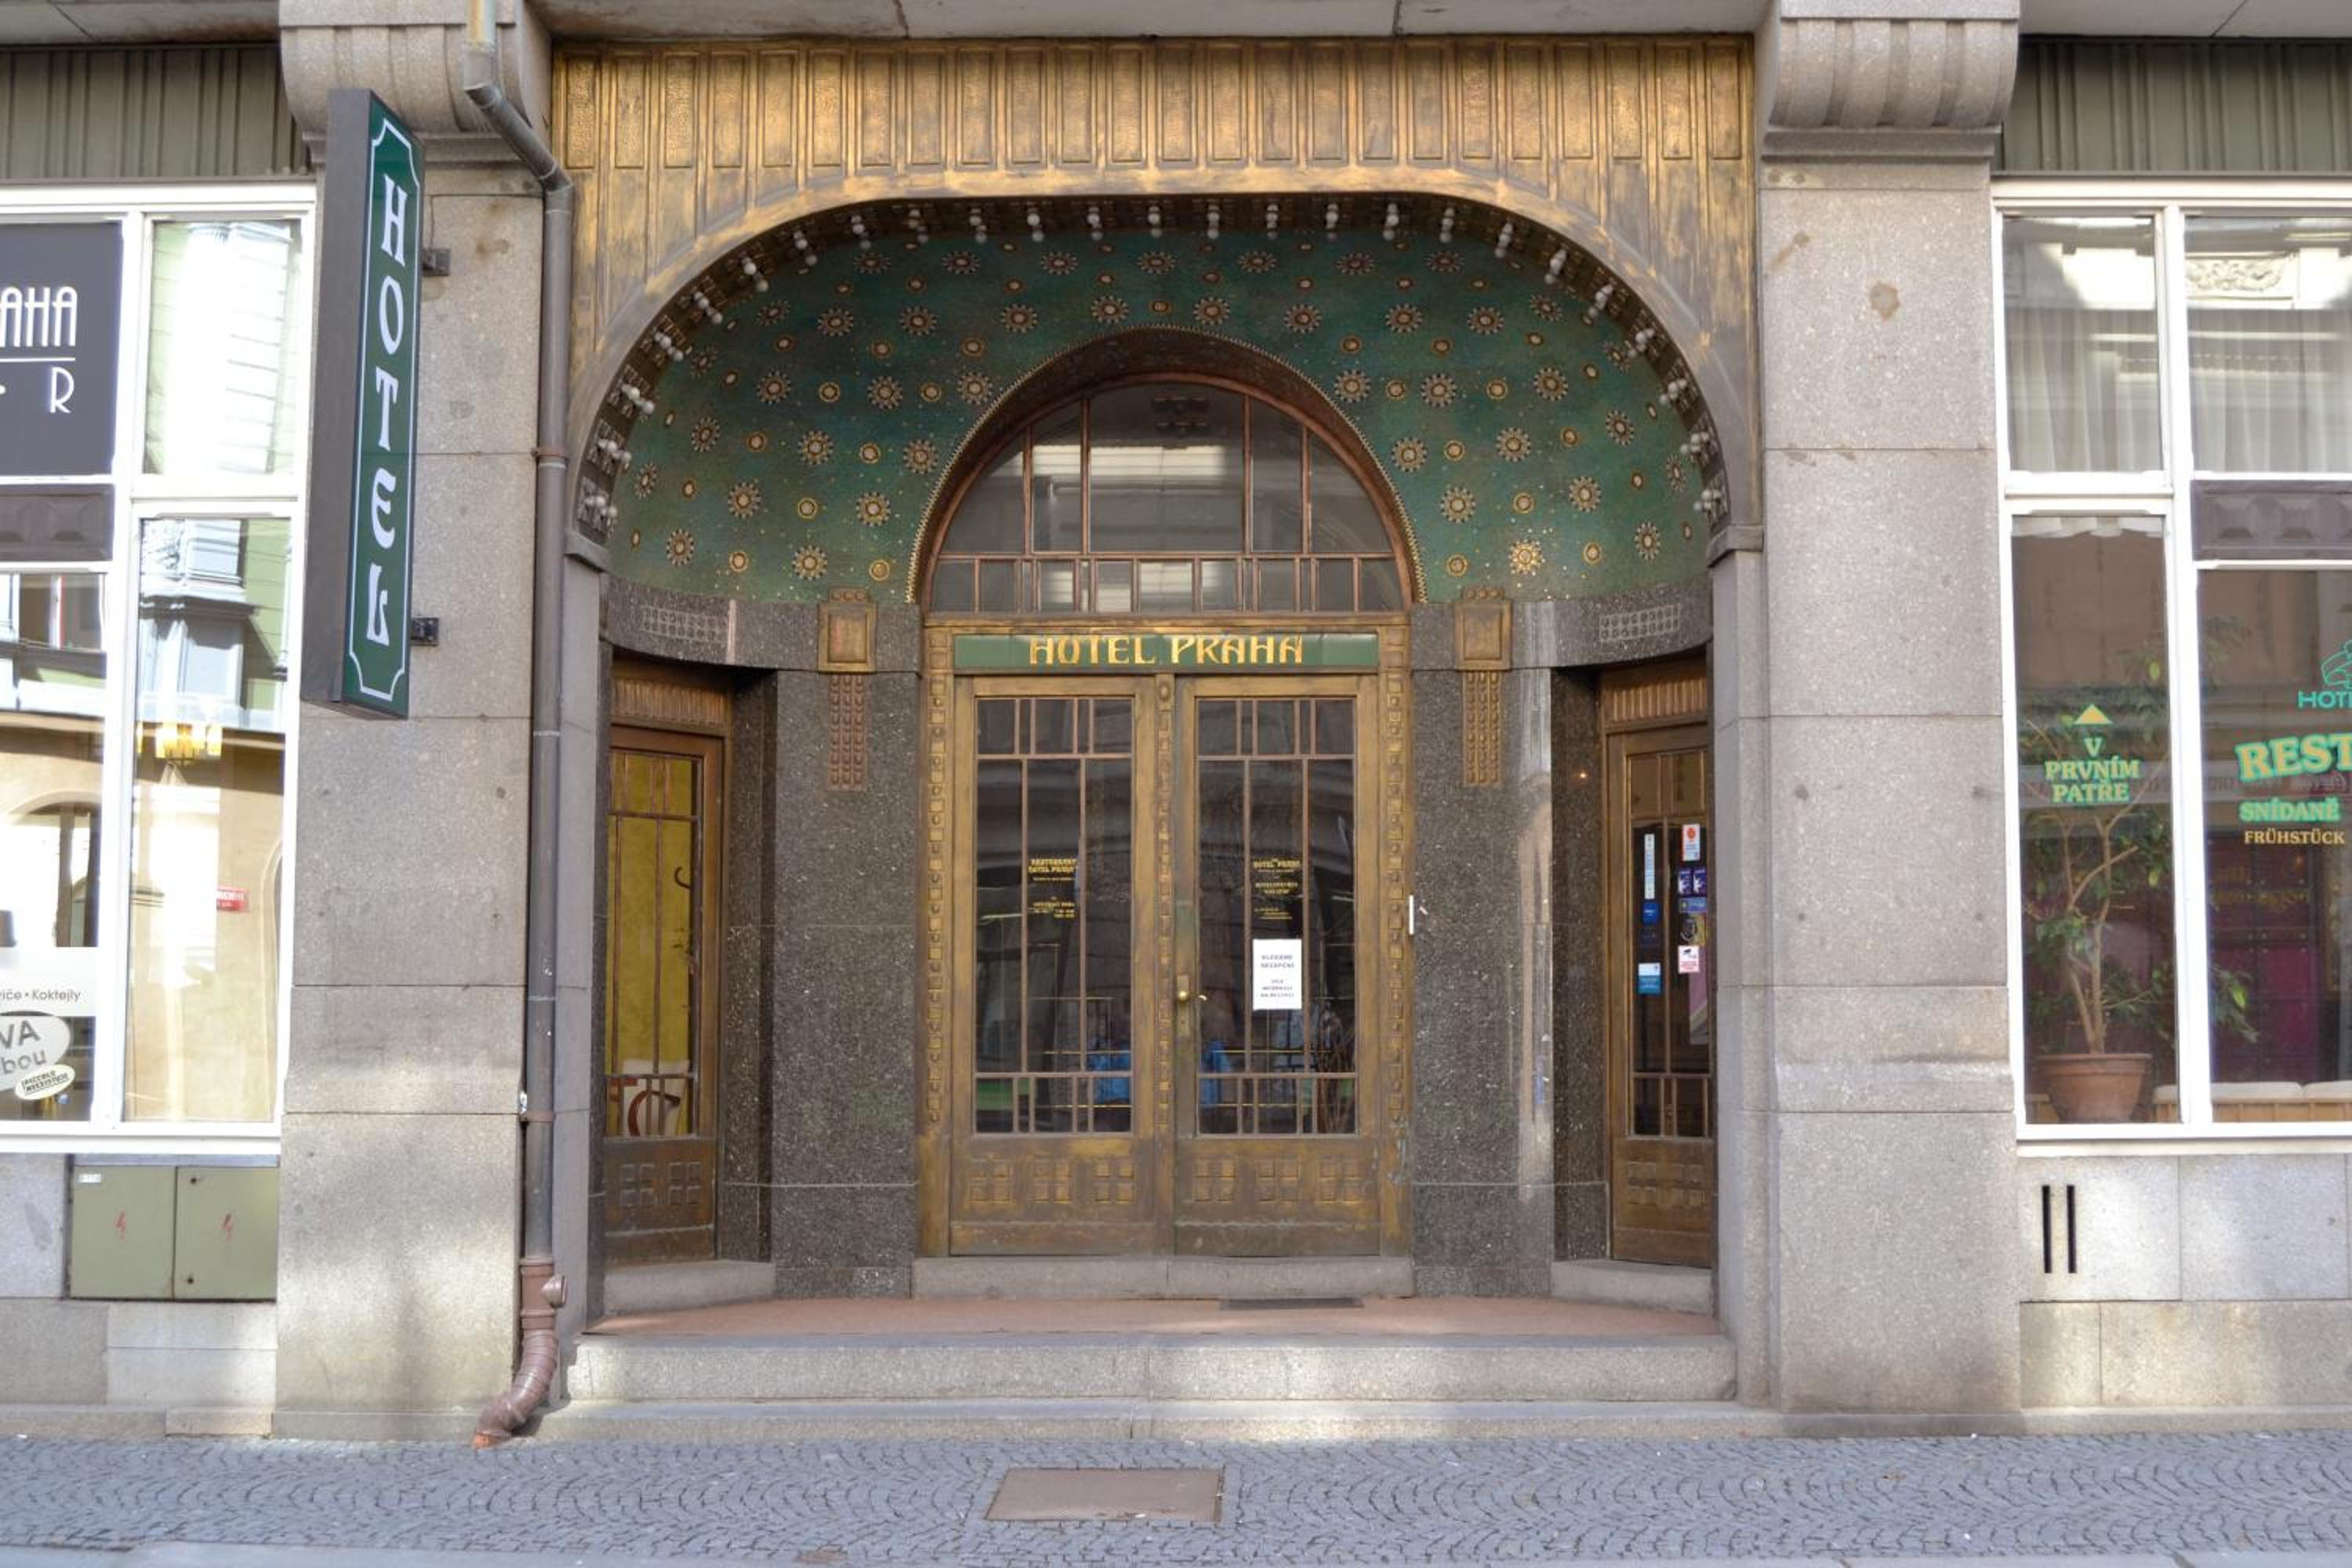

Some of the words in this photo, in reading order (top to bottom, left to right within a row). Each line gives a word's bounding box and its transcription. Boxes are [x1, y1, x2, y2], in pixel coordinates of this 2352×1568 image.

[49, 366, 74, 413] R
[366, 175, 408, 647] HOTEL
[1029, 634, 1156, 665] HOTEL
[1171, 633, 1304, 665] PRAHA
[2083, 737, 2103, 757] V
[2044, 755, 2141, 779] PRVNÍM
[2052, 778, 2130, 804] PATŘE
[2238, 797, 2342, 822] SNÍDANĚ
[2244, 827, 2346, 844] FRÜHSTÜCK
[32, 989, 82, 1002] Koktejly
